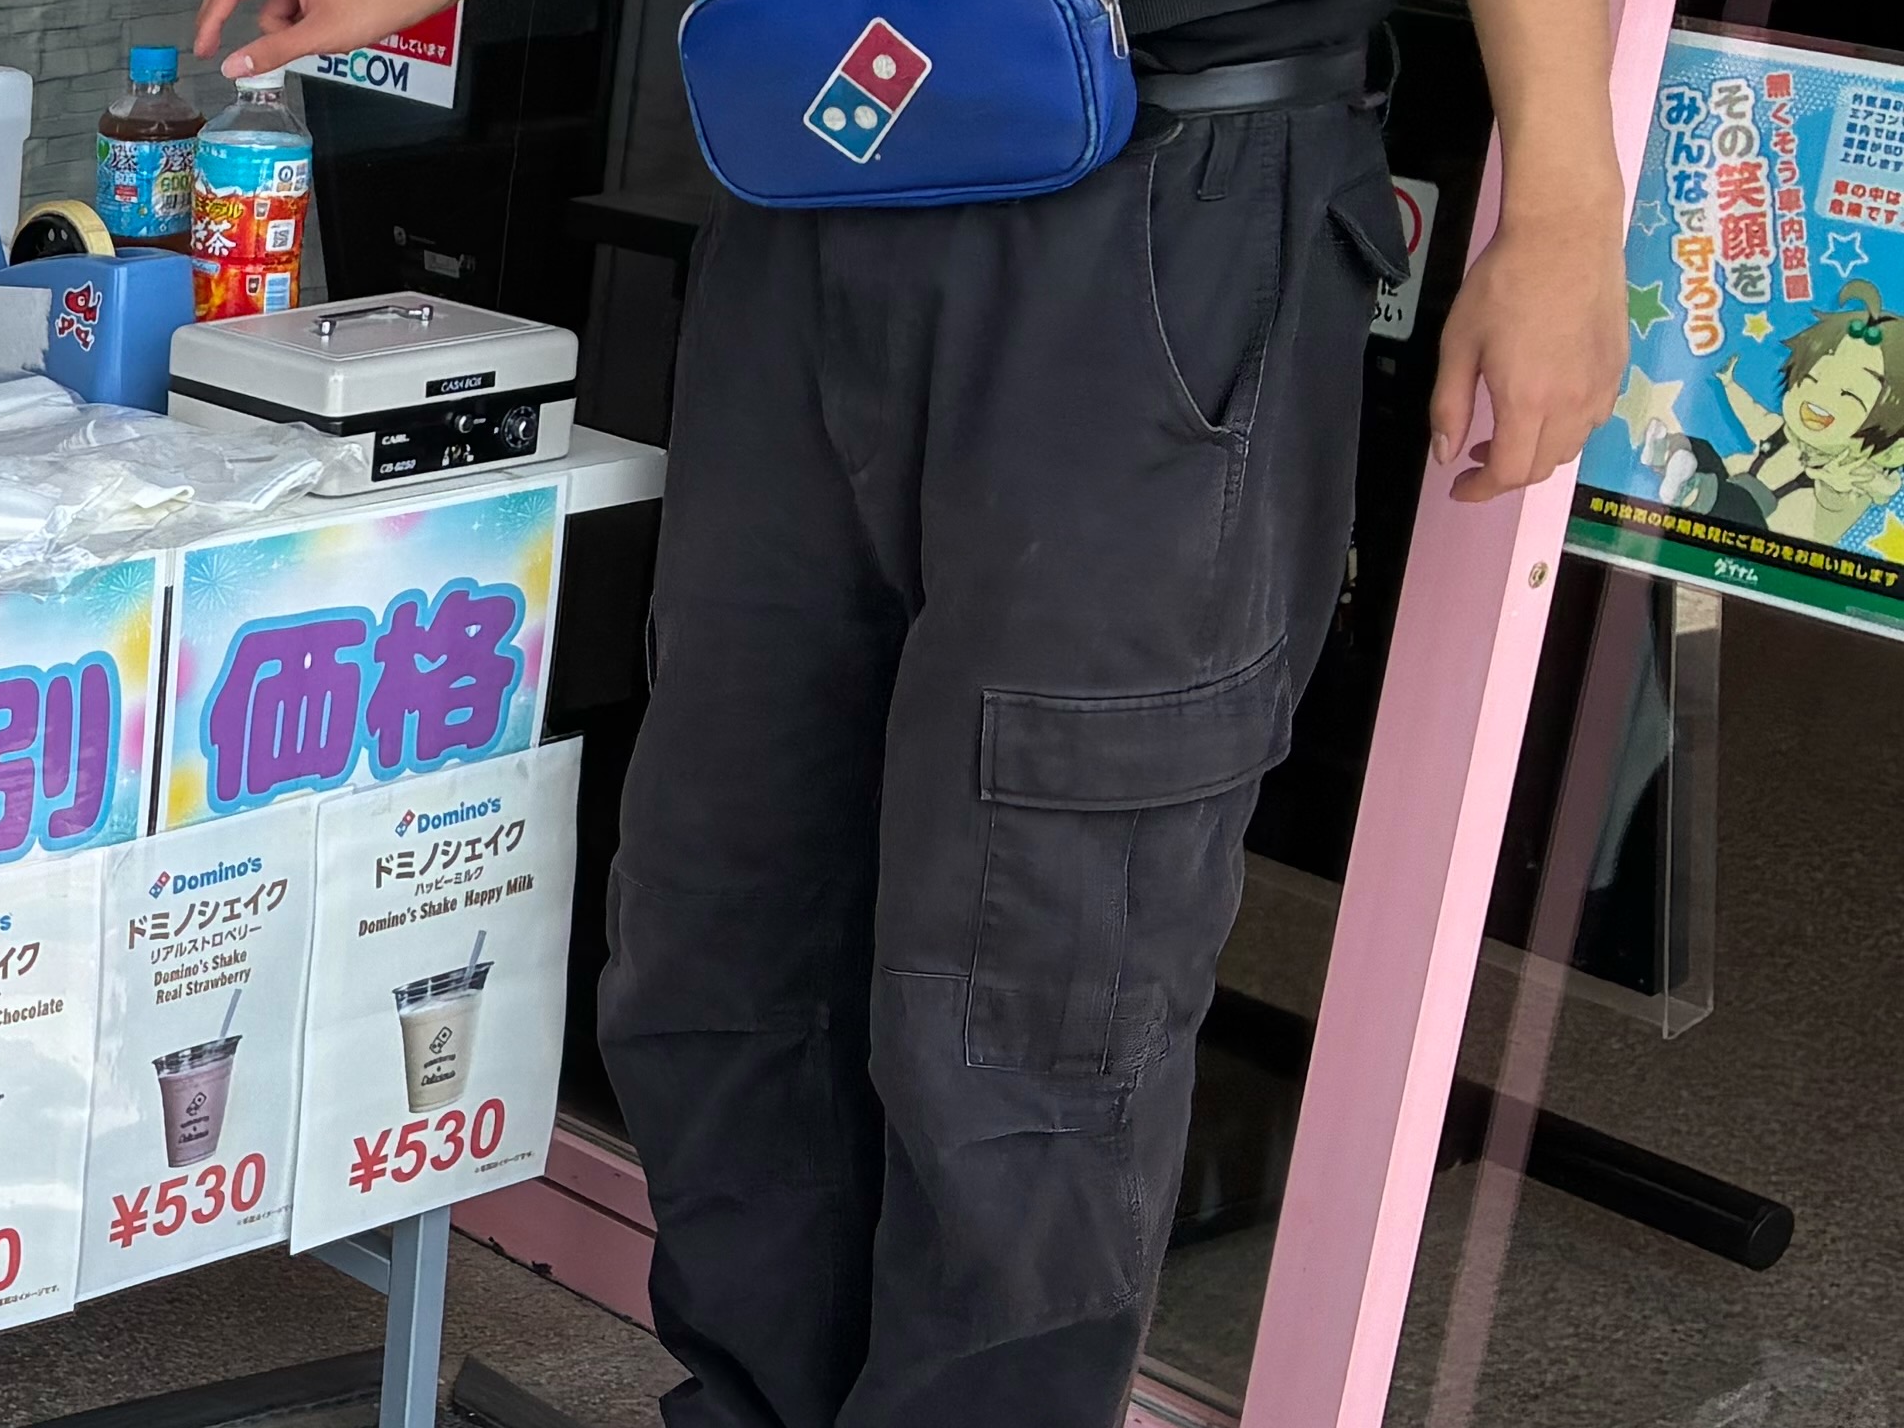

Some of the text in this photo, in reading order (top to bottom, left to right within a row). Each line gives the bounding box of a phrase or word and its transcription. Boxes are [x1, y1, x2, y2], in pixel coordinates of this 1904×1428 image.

[1665, 92, 1720, 351] みんなで守ろう
[1713, 84, 1772, 299] その笑顔を
[201, 578, 527, 812] 価格
[417, 797, 501, 833] Domino's
[173, 857, 262, 894] Domino's
[376, 819, 525, 888] ドミノシェイク
[414, 866, 483, 896] ハッピーミルク
[129, 879, 288, 949] ドミノシェイク
[359, 874, 534, 937] Domino's Shake Happy Milk
[151, 924, 262, 965] リアルストロベリー
[154, 949, 247, 987] Domino's Shake
[156, 968, 251, 1005] Real Strawberry
[348, 1098, 505, 1193] ¥530
[109, 1153, 266, 1248] ¥530
